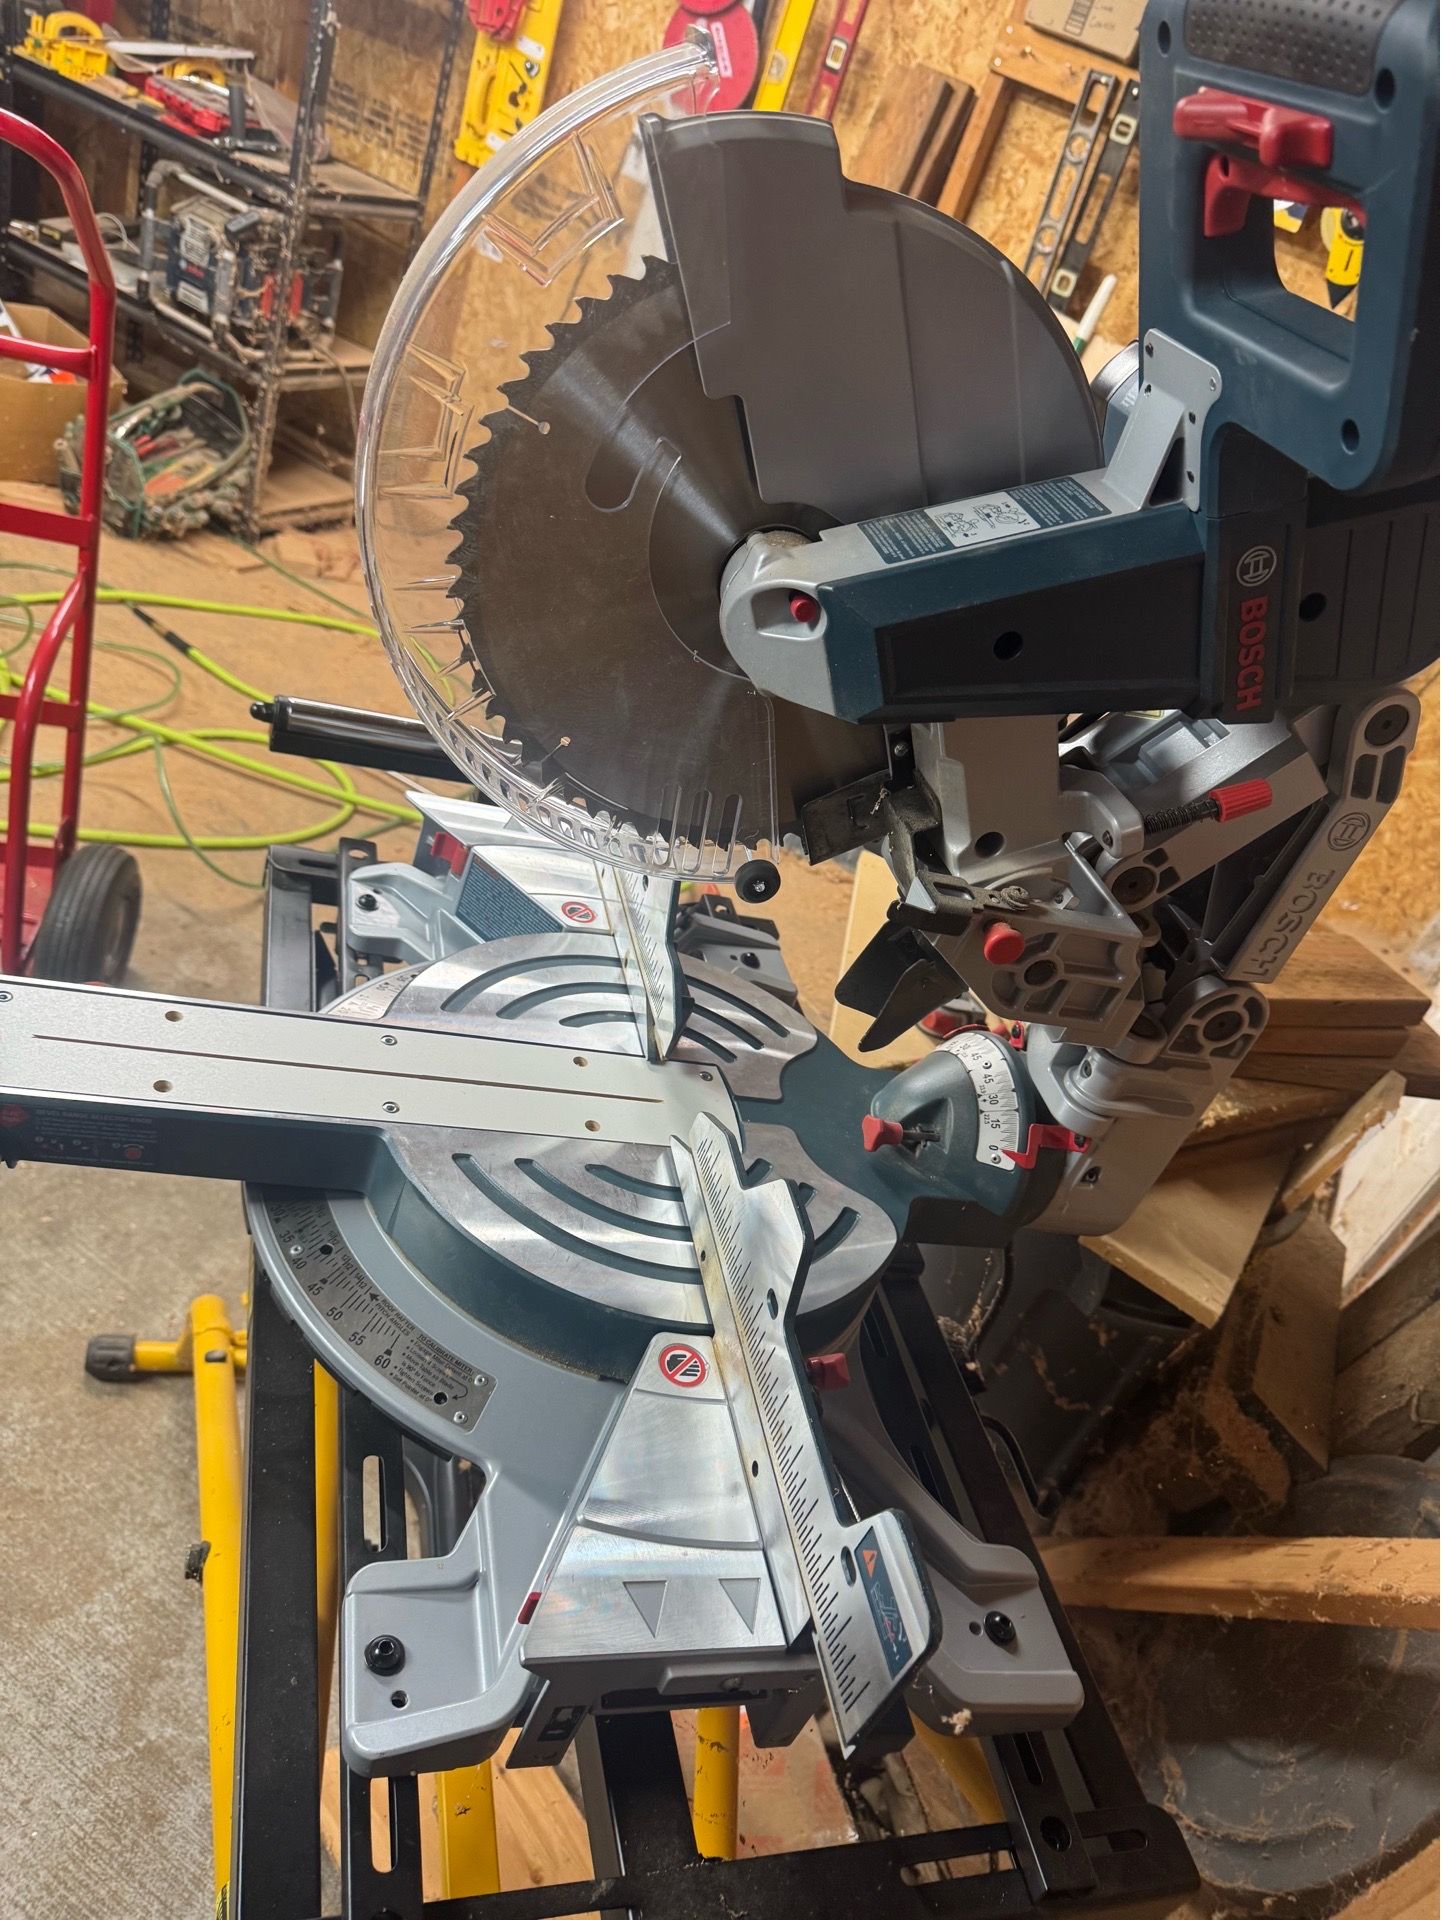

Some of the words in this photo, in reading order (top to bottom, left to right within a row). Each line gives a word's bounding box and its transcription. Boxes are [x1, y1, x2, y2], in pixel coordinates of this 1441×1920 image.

[1236, 596, 1270, 711] BOSCH
[1242, 869, 1336, 977] BOSCH
[983, 1073, 994, 1085] 45
[988, 1094, 999, 1105] 30
[990, 1118, 1001, 1129] 15
[280, 1230, 295, 1243] 35
[292, 1257, 307, 1270] 40
[307, 1283, 324, 1296] 45
[326, 1306, 343, 1321] 50
[375, 1303, 391, 1318] PITCH
[389, 1317, 410, 1336] ANGLES
[381, 1299, 394, 1313] ROOF
[395, 1312, 415, 1331] RAFTER
[349, 1331, 366, 1346] 55
[418, 1333, 427, 1341] TO
[425, 1339, 455, 1361] CALIBRATE
[374, 1354, 391, 1369] 60
[405, 1354, 420, 1366] Move
